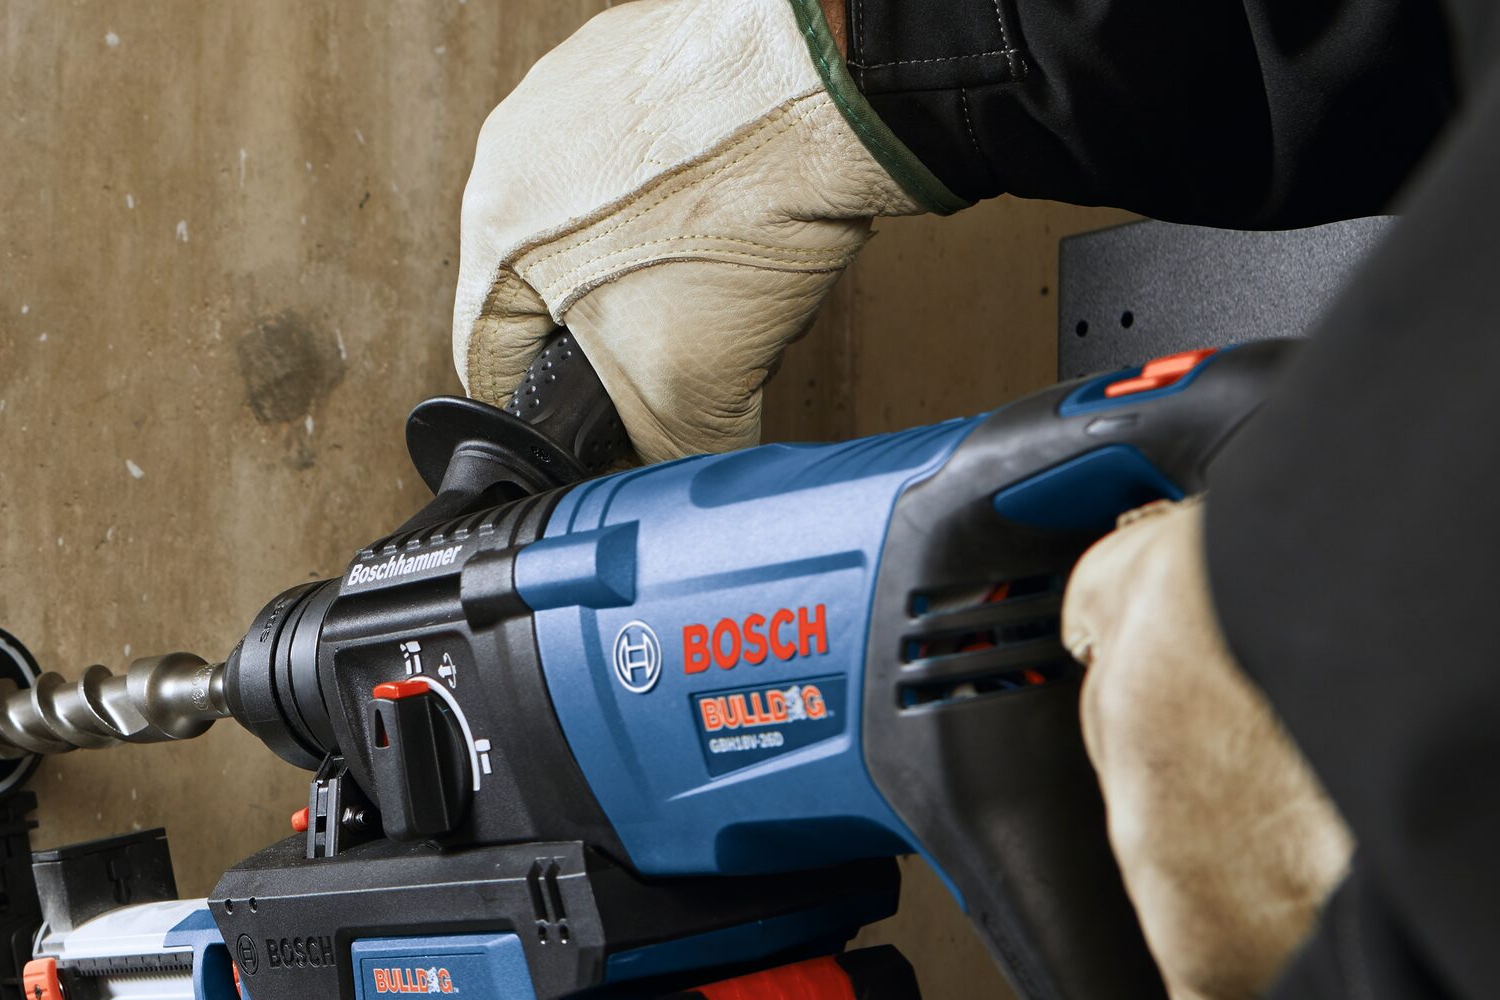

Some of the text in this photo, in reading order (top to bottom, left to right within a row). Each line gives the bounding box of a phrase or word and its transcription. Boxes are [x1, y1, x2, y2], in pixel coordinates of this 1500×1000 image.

[347, 545, 463, 586] Boschhammer
[682, 603, 828, 675] BOSCH
[700, 685, 827, 731] BULLDG
[266, 936, 336, 968] BOSCH
[373, 967, 453, 994] BULLDG
